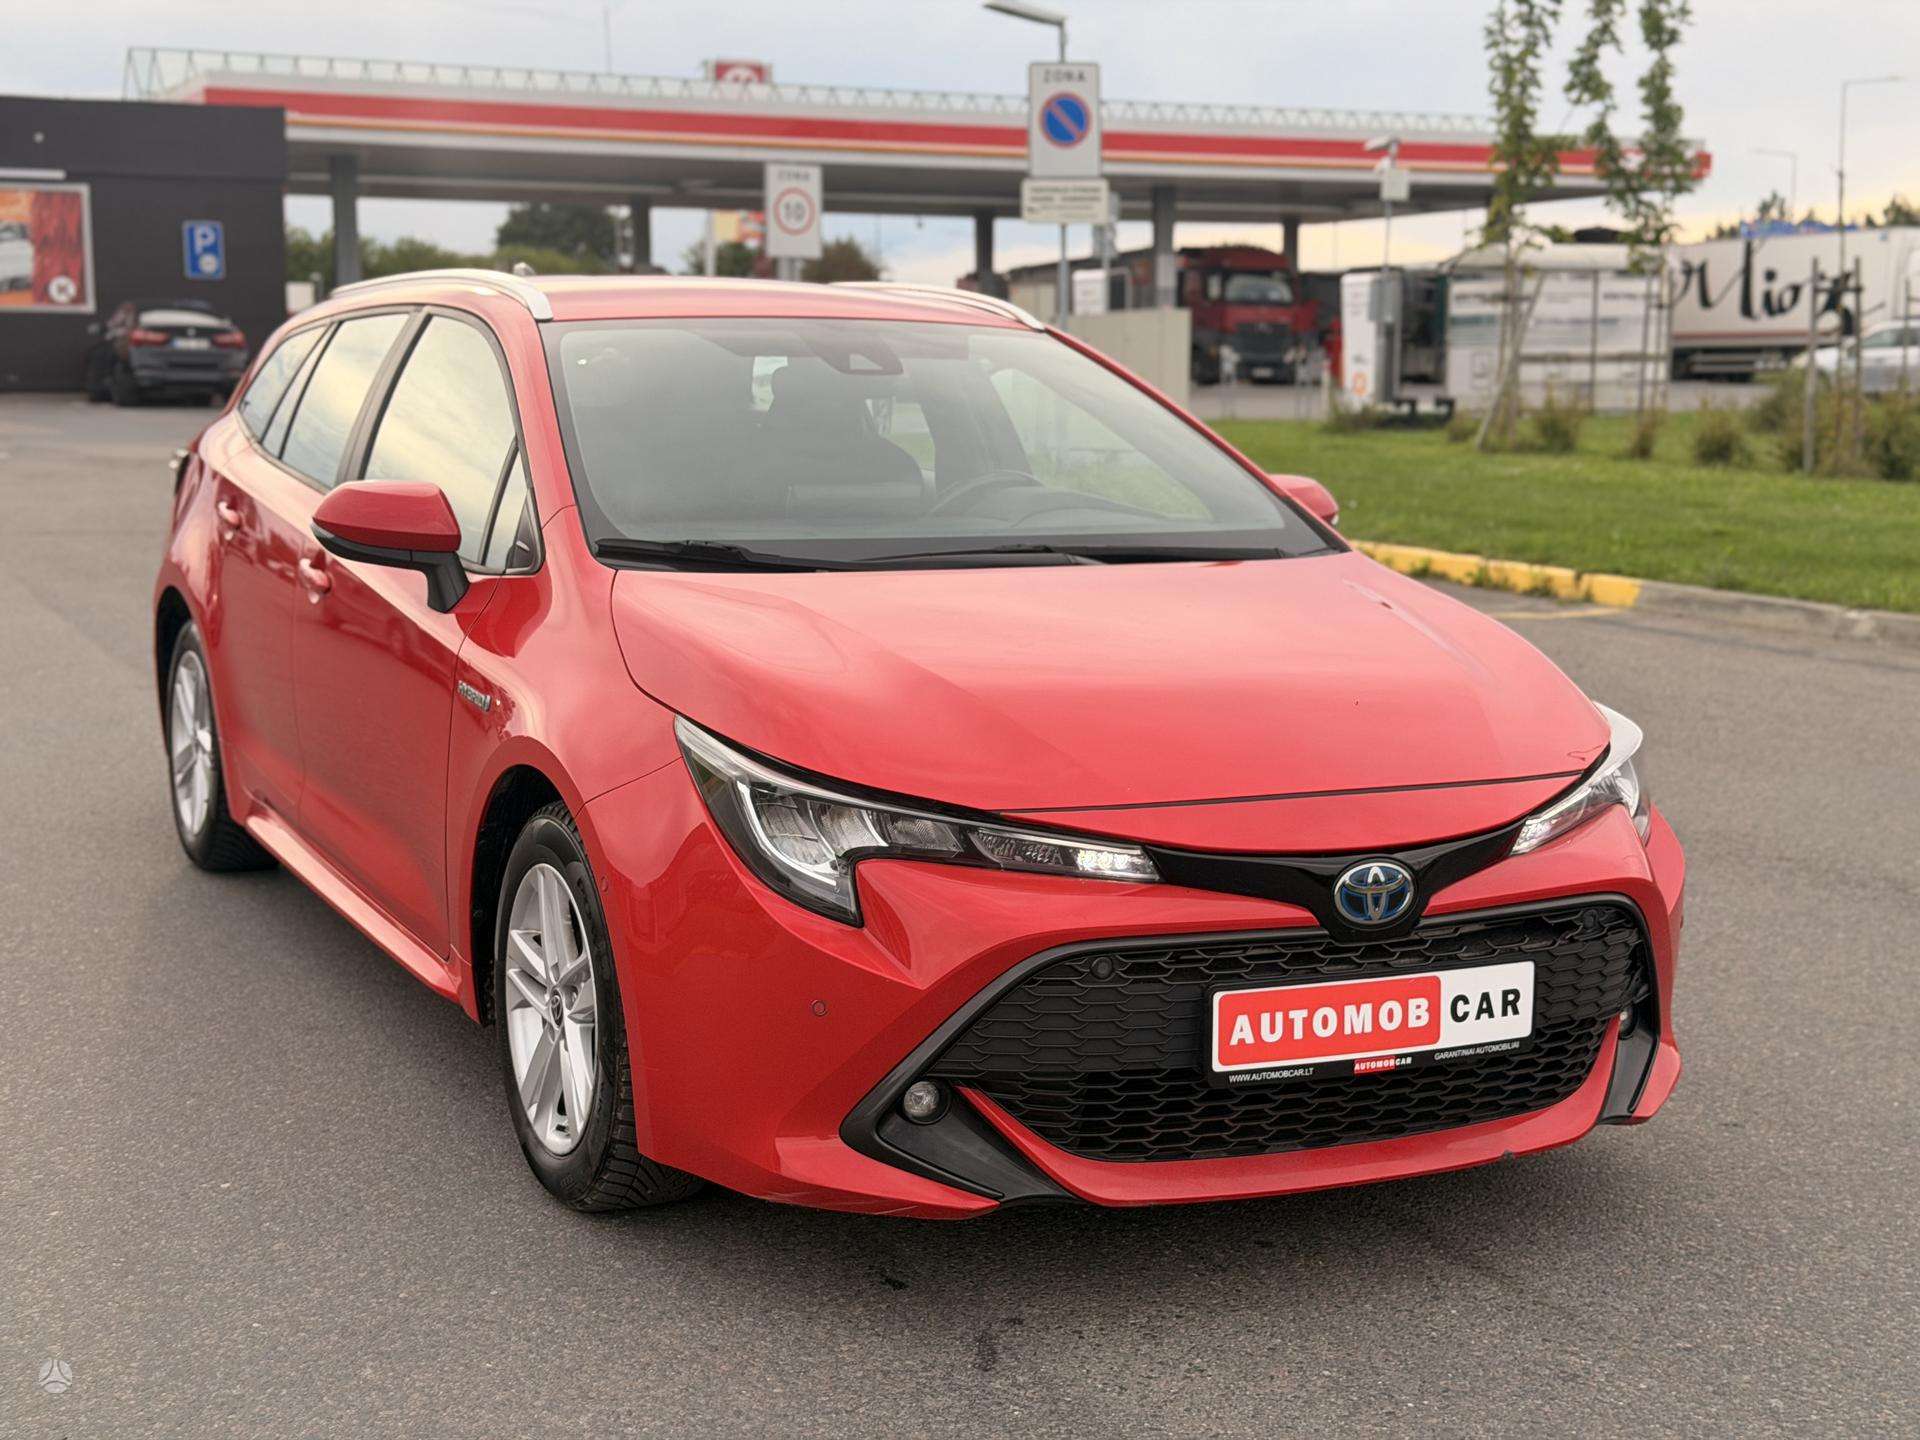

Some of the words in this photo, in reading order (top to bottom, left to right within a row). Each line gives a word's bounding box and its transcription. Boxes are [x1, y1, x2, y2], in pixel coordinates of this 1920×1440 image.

[1044, 69, 1085, 82] ZONA
[194, 224, 215, 254] P
[1229, 997, 1430, 1046] AUTOMOB
[1449, 988, 1520, 1022] CAR
[1229, 1067, 1314, 1083] WWW.AUTOMOBCAR.LT
